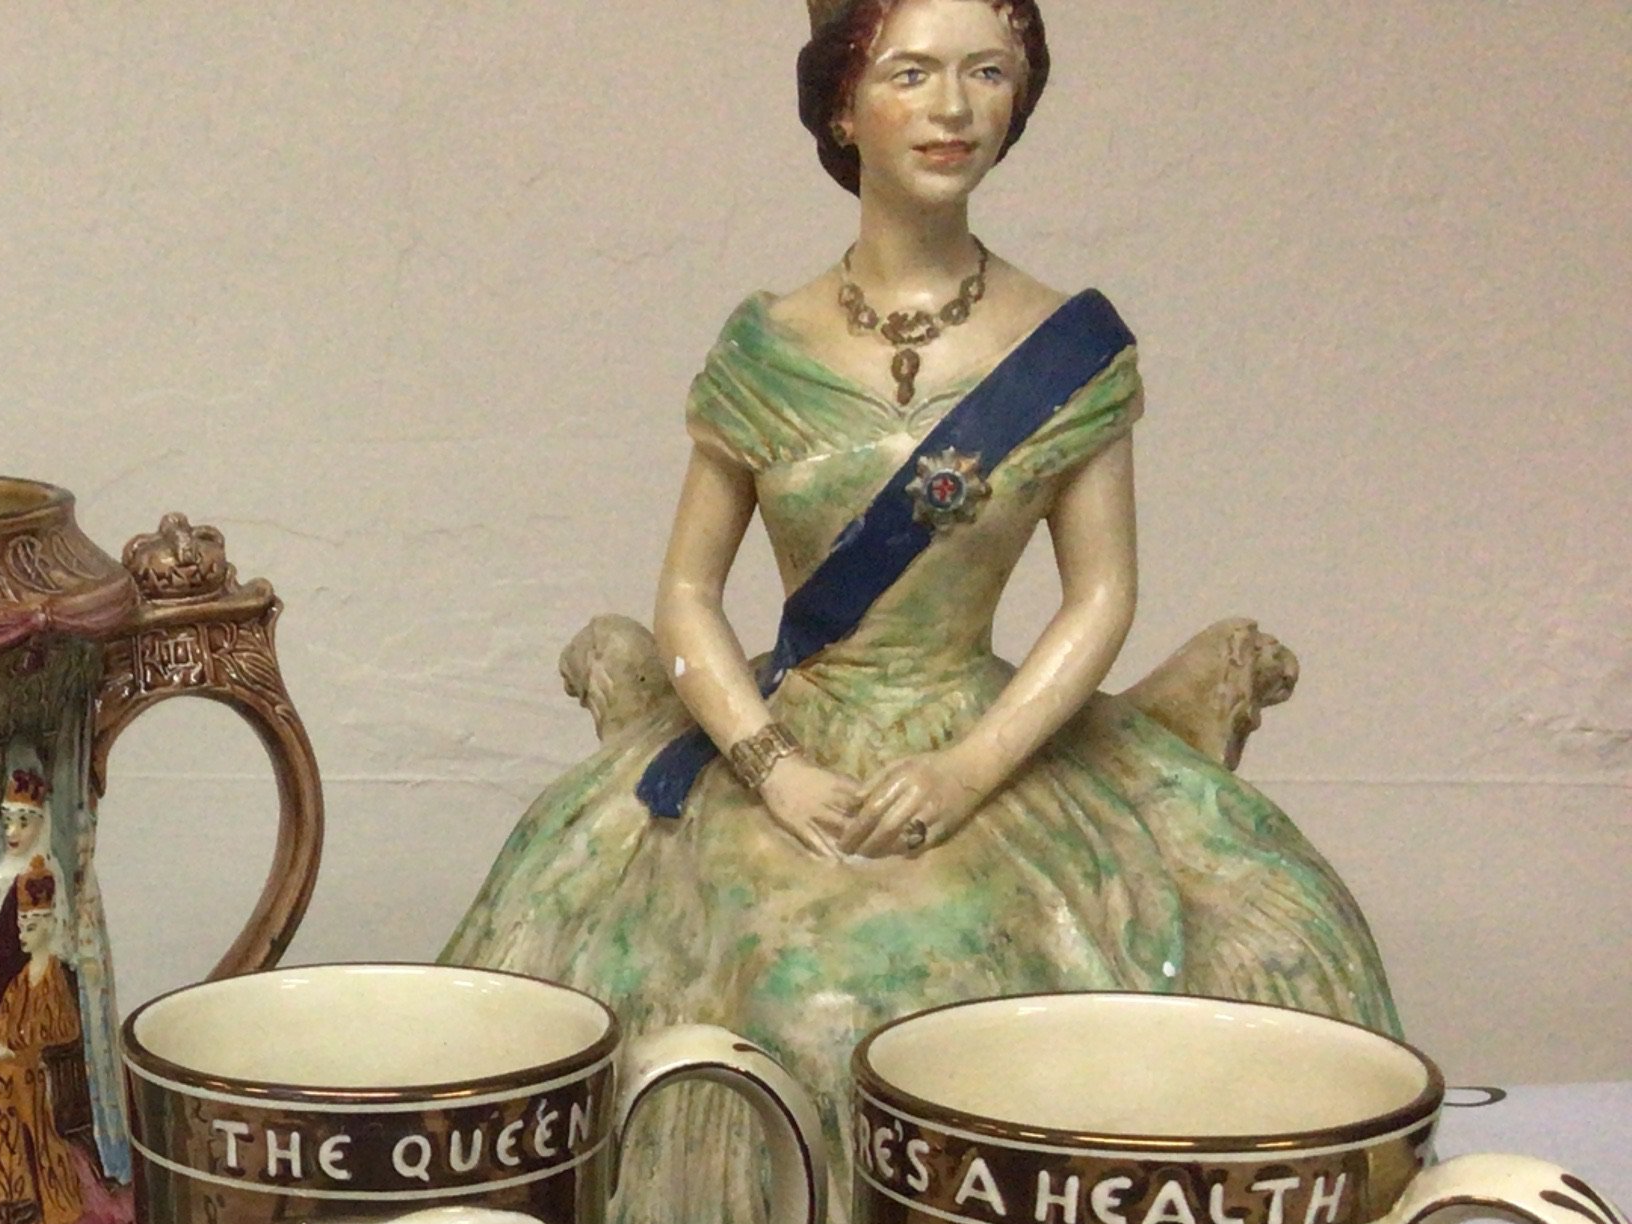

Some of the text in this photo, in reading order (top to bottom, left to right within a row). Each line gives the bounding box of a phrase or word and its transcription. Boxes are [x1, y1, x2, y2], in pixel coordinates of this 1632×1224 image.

[212, 1095, 592, 1181] THE QUEEN
[955, 1156, 1007, 1216] A
